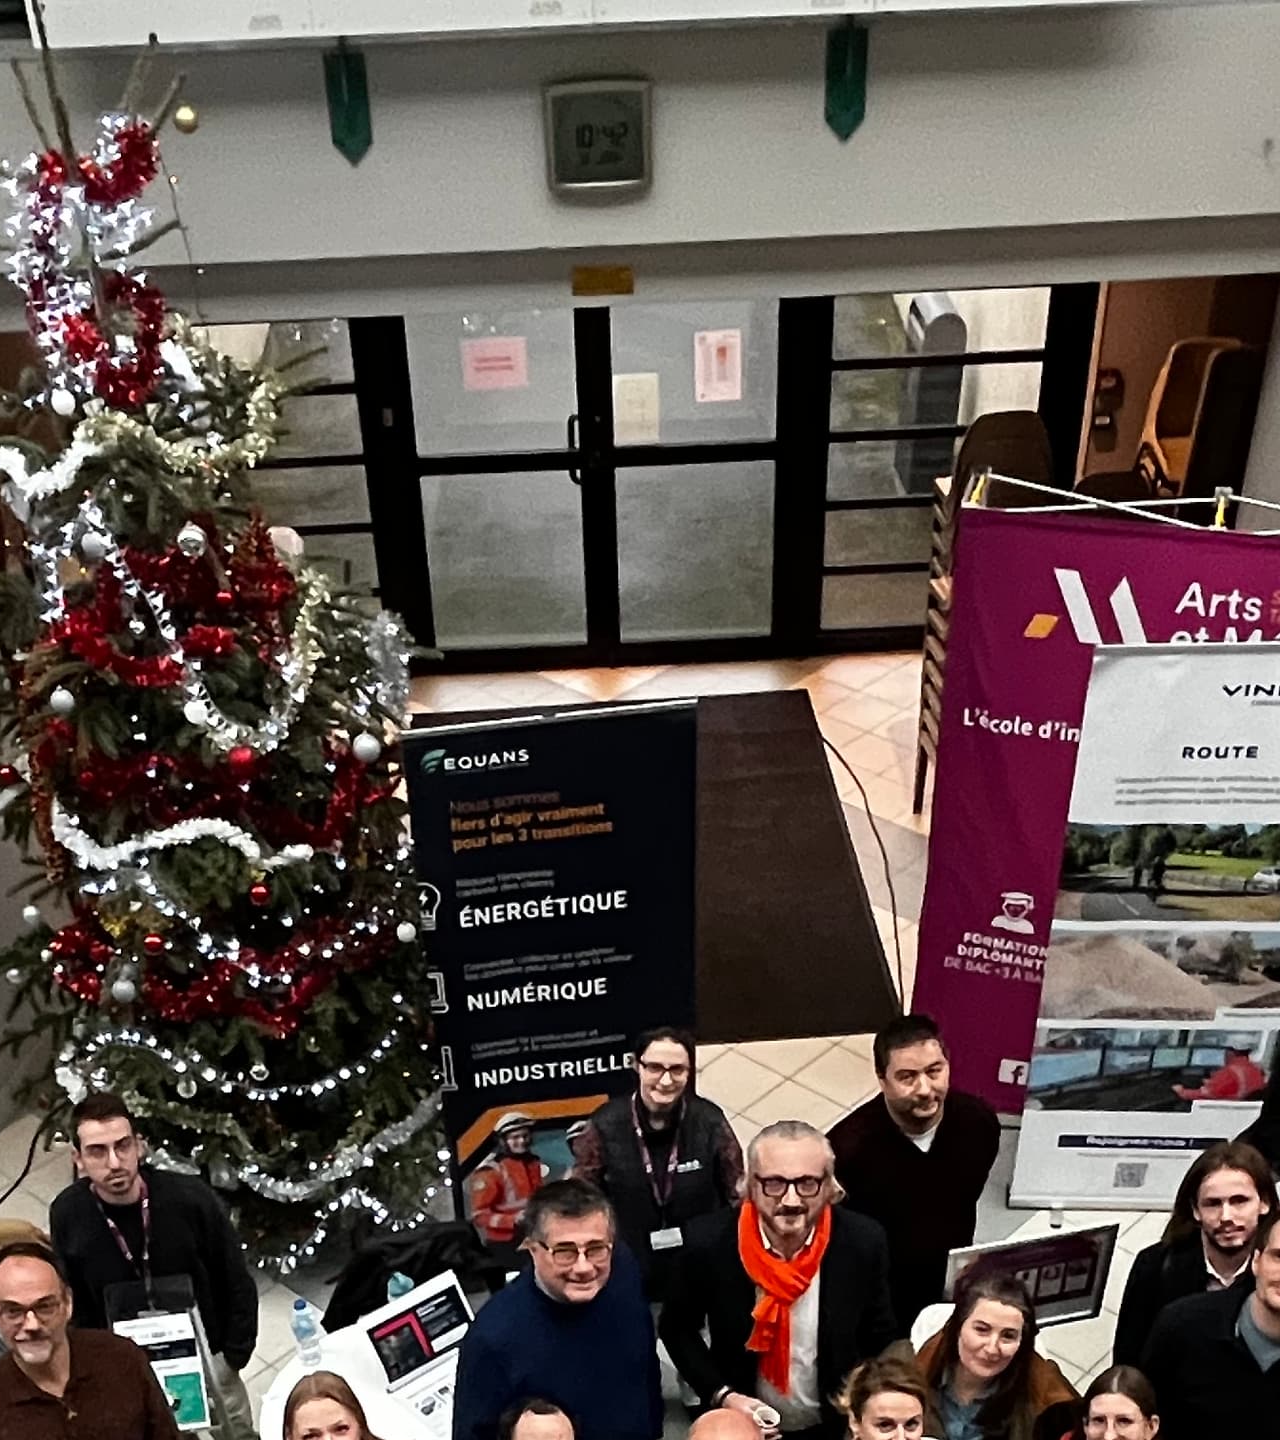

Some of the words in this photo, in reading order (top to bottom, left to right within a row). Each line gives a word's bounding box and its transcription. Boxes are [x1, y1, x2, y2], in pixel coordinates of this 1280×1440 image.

[1175, 582, 1263, 622] Arts
[963, 707, 1033, 736] L'école
[443, 749, 530, 771] EQUANS
[1182, 745, 1259, 760] ROUTE
[537, 803, 605, 821] vraiment
[452, 836, 488, 854] pour
[491, 831, 514, 845] les
[532, 821, 613, 840] transitions
[459, 890, 628, 928] ÉNERGÉTIQUE
[467, 977, 607, 1011] NUMÉRIQUE
[474, 1052, 635, 1088] INDUSTRIELLE
